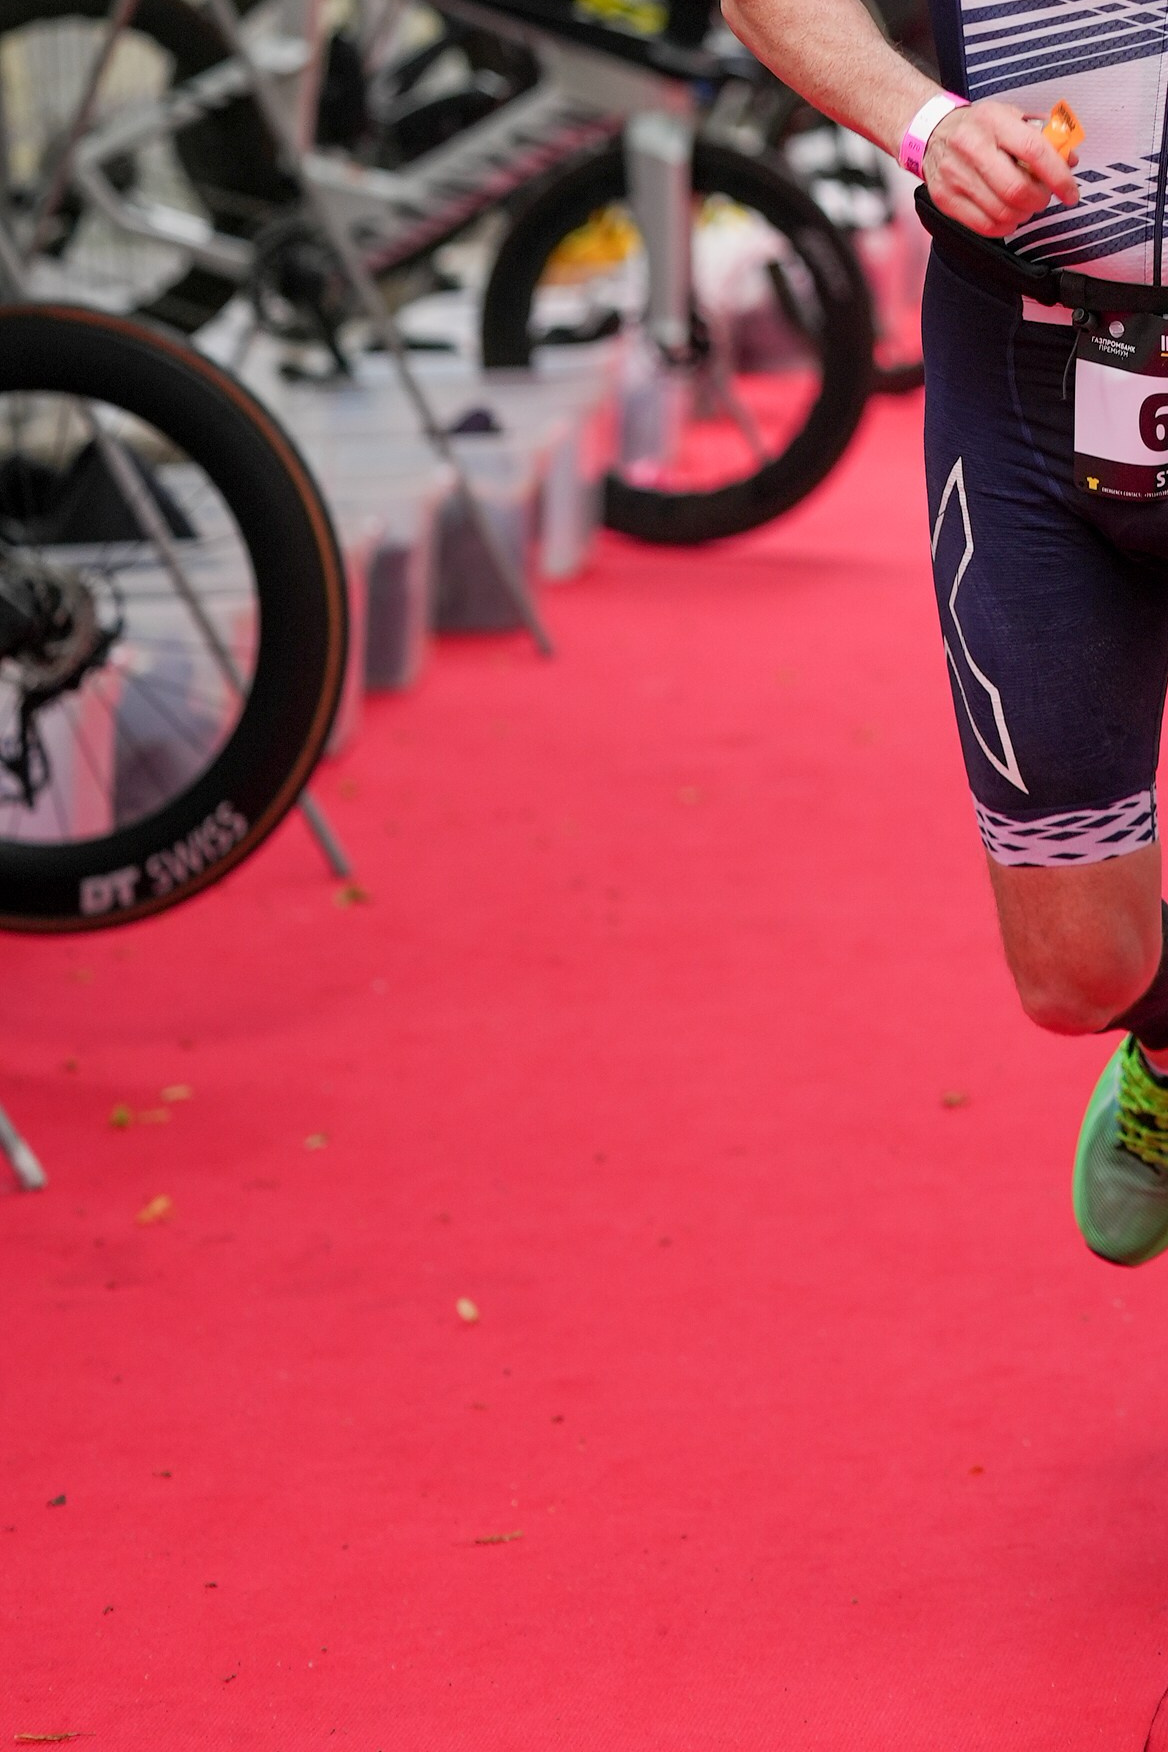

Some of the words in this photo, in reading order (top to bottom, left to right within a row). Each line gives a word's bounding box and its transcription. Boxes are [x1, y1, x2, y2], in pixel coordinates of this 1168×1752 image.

[1091, 335, 1136, 354] ГАЗПРОМБАНК
[80, 866, 140, 916] DT
[145, 800, 249, 895] SWISS
